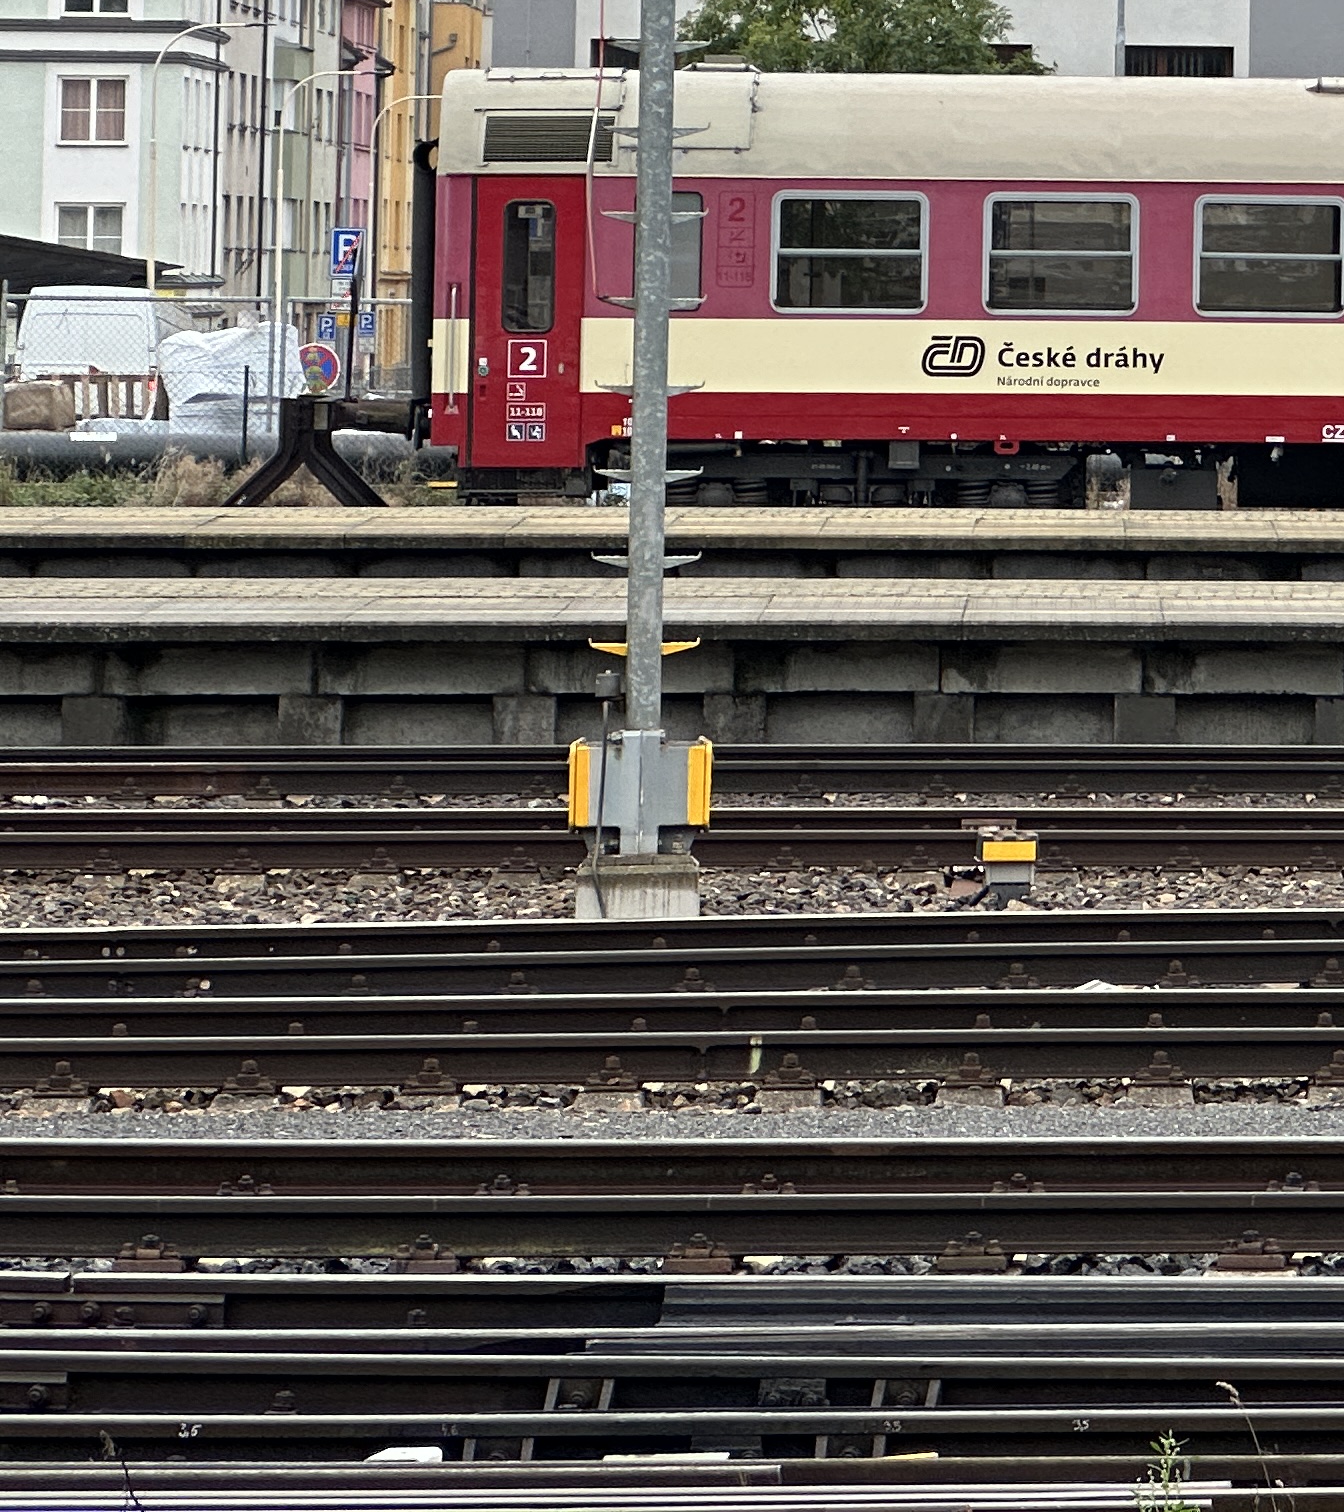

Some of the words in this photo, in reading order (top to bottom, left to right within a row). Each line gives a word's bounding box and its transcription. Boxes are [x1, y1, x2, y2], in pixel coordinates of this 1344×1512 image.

[728, 197, 746, 222] 2
[518, 346, 538, 371] 2
[997, 341, 1077, 369] České
[1086, 345, 1165, 374] dráhy
[997, 375, 1044, 387] Národní
[1046, 375, 1101, 389] dopravce
